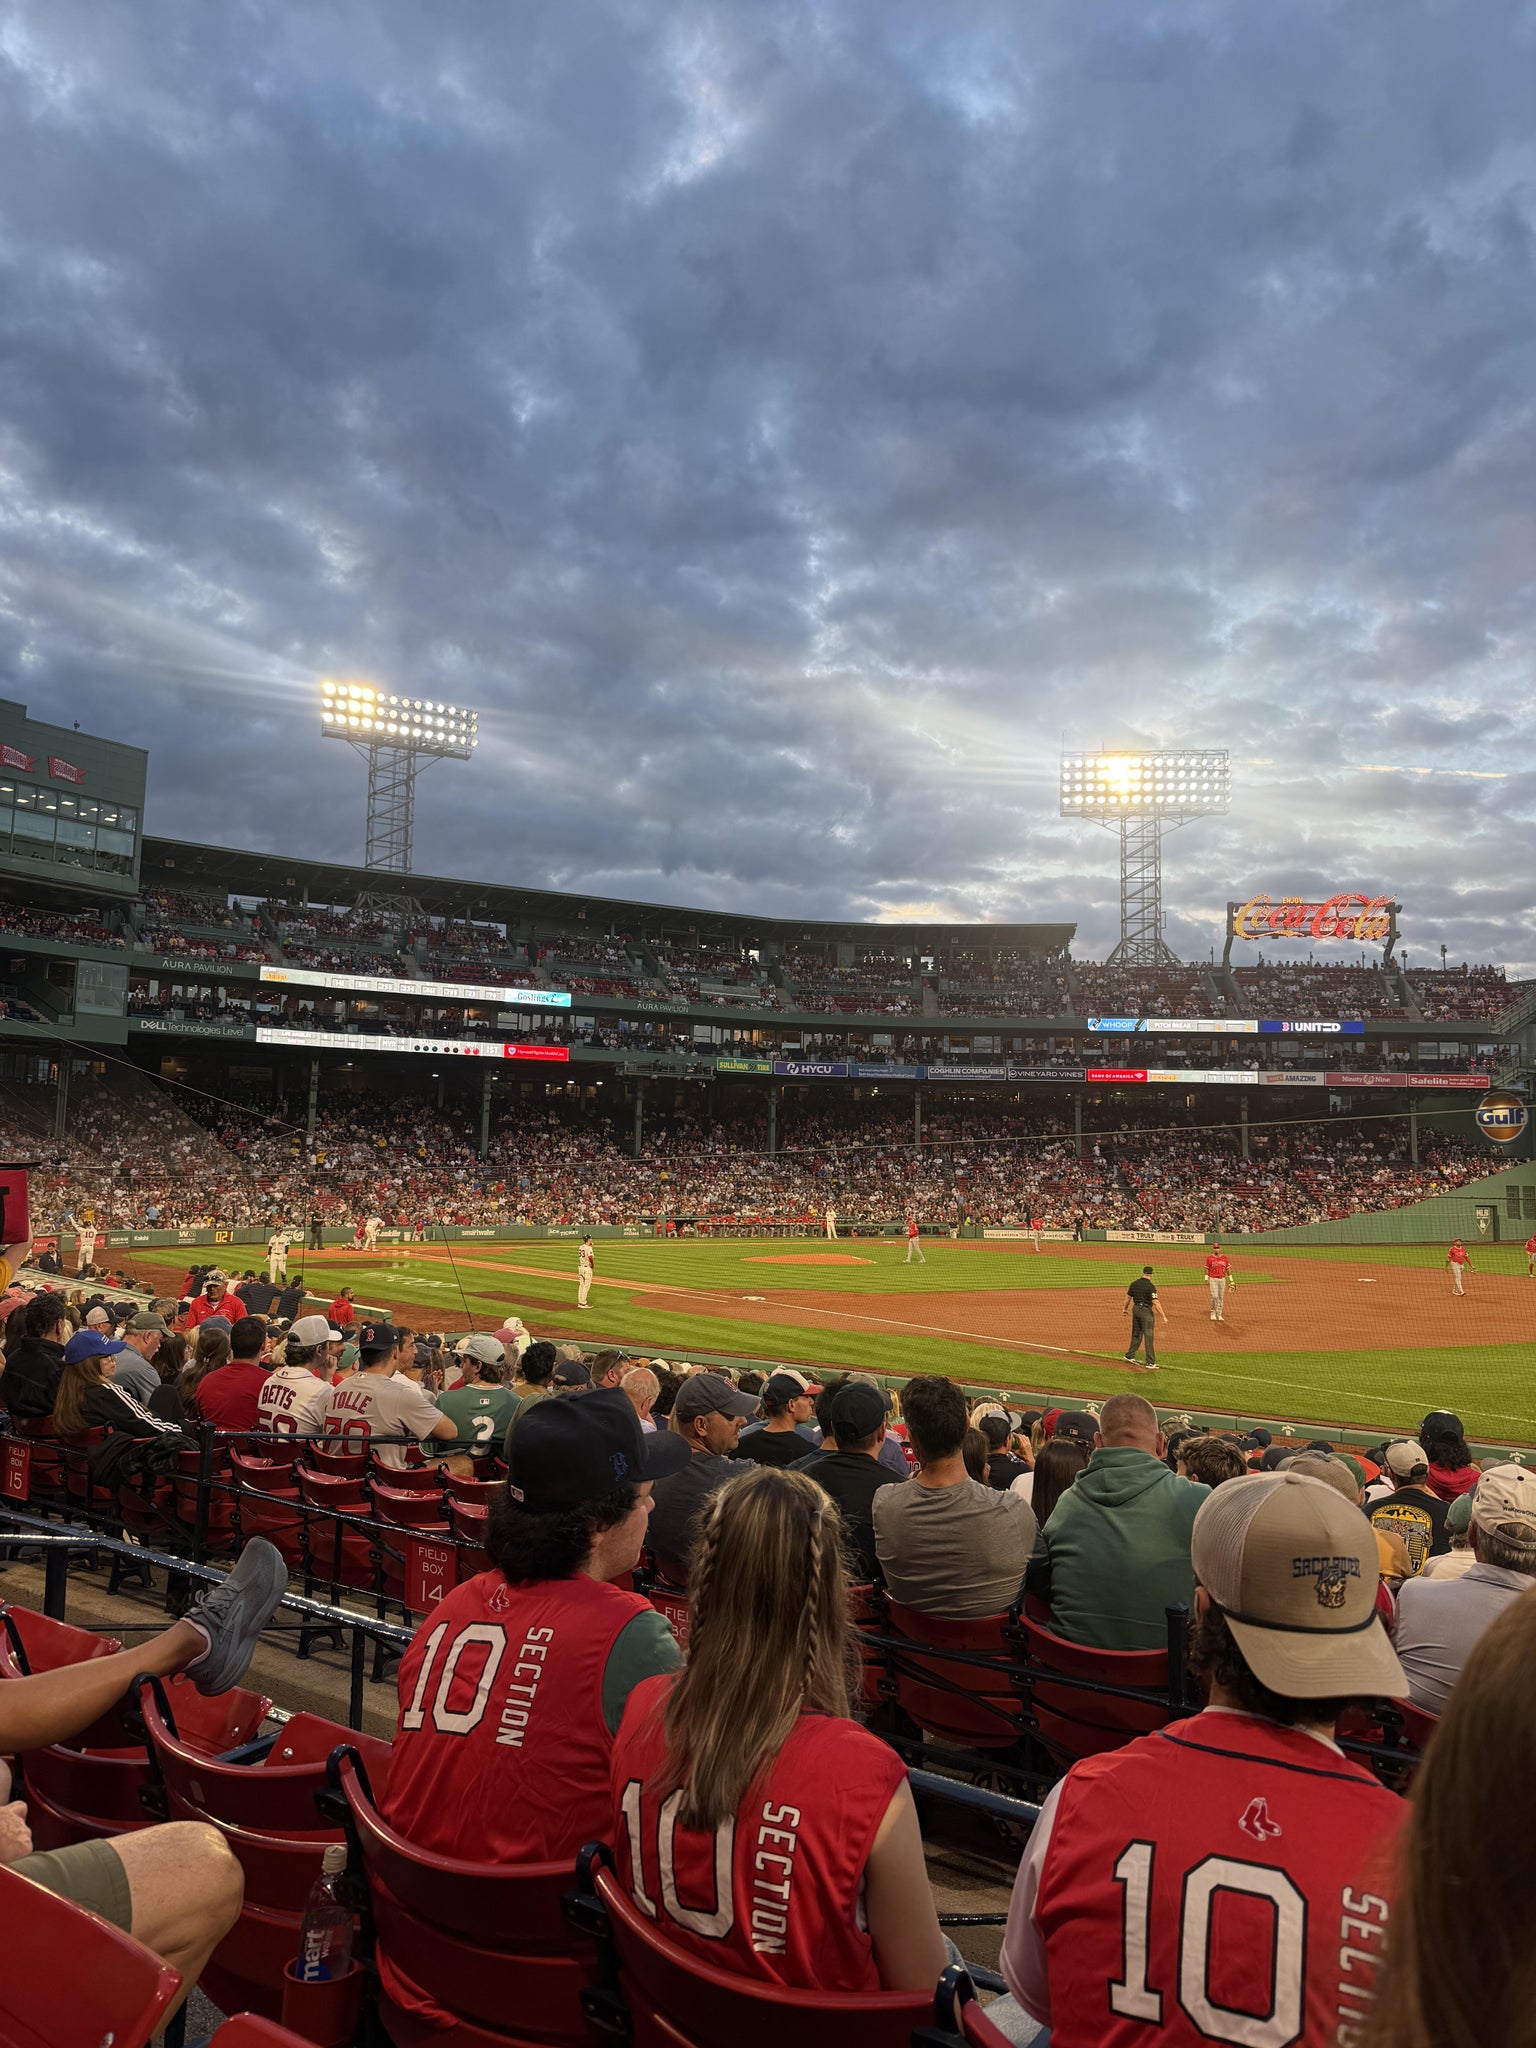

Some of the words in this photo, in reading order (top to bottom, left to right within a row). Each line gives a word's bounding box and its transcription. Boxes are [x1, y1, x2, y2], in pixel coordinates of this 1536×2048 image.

[1233, 893, 1397, 940] Coca-Cola
[193, 963, 233, 974] PAVILION
[517, 992, 550, 1003] Goslings
[659, 1004, 689, 1014] PAVILION
[141, 1020, 167, 1031] DELL
[167, 1022, 221, 1036] Technologies
[222, 1026, 244, 1037] Level
[1103, 1021, 1133, 1029] WHOOP
[1295, 1022, 1341, 1032] UNITED
[719, 1060, 748, 1070] SULLIVAN
[801, 1065, 832, 1074] HYCU
[1411, 1077, 1448, 1085] Safelite
[1478, 1109, 1524, 1125] Gulf
[84, 1231, 94, 1239] 10
[262, 1384, 297, 1410] BETTS
[332, 1391, 373, 1415] TOLLE
[9, 1446, 25, 1457] FIELD
[10, 1457, 23, 1468] BOX
[9, 1471, 22, 1490] 15
[418, 1546, 448, 1563] FIELD
[422, 1561, 444, 1576] BOX
[422, 1579, 444, 1602] 14
[402, 1620, 508, 1737] 10
[495, 1625, 555, 1748] SECTION
[621, 1777, 737, 1940] 10
[751, 1800, 801, 1956] SECTION
[1107, 1838, 1309, 2048] 10
[303, 1929, 326, 1982] mart
